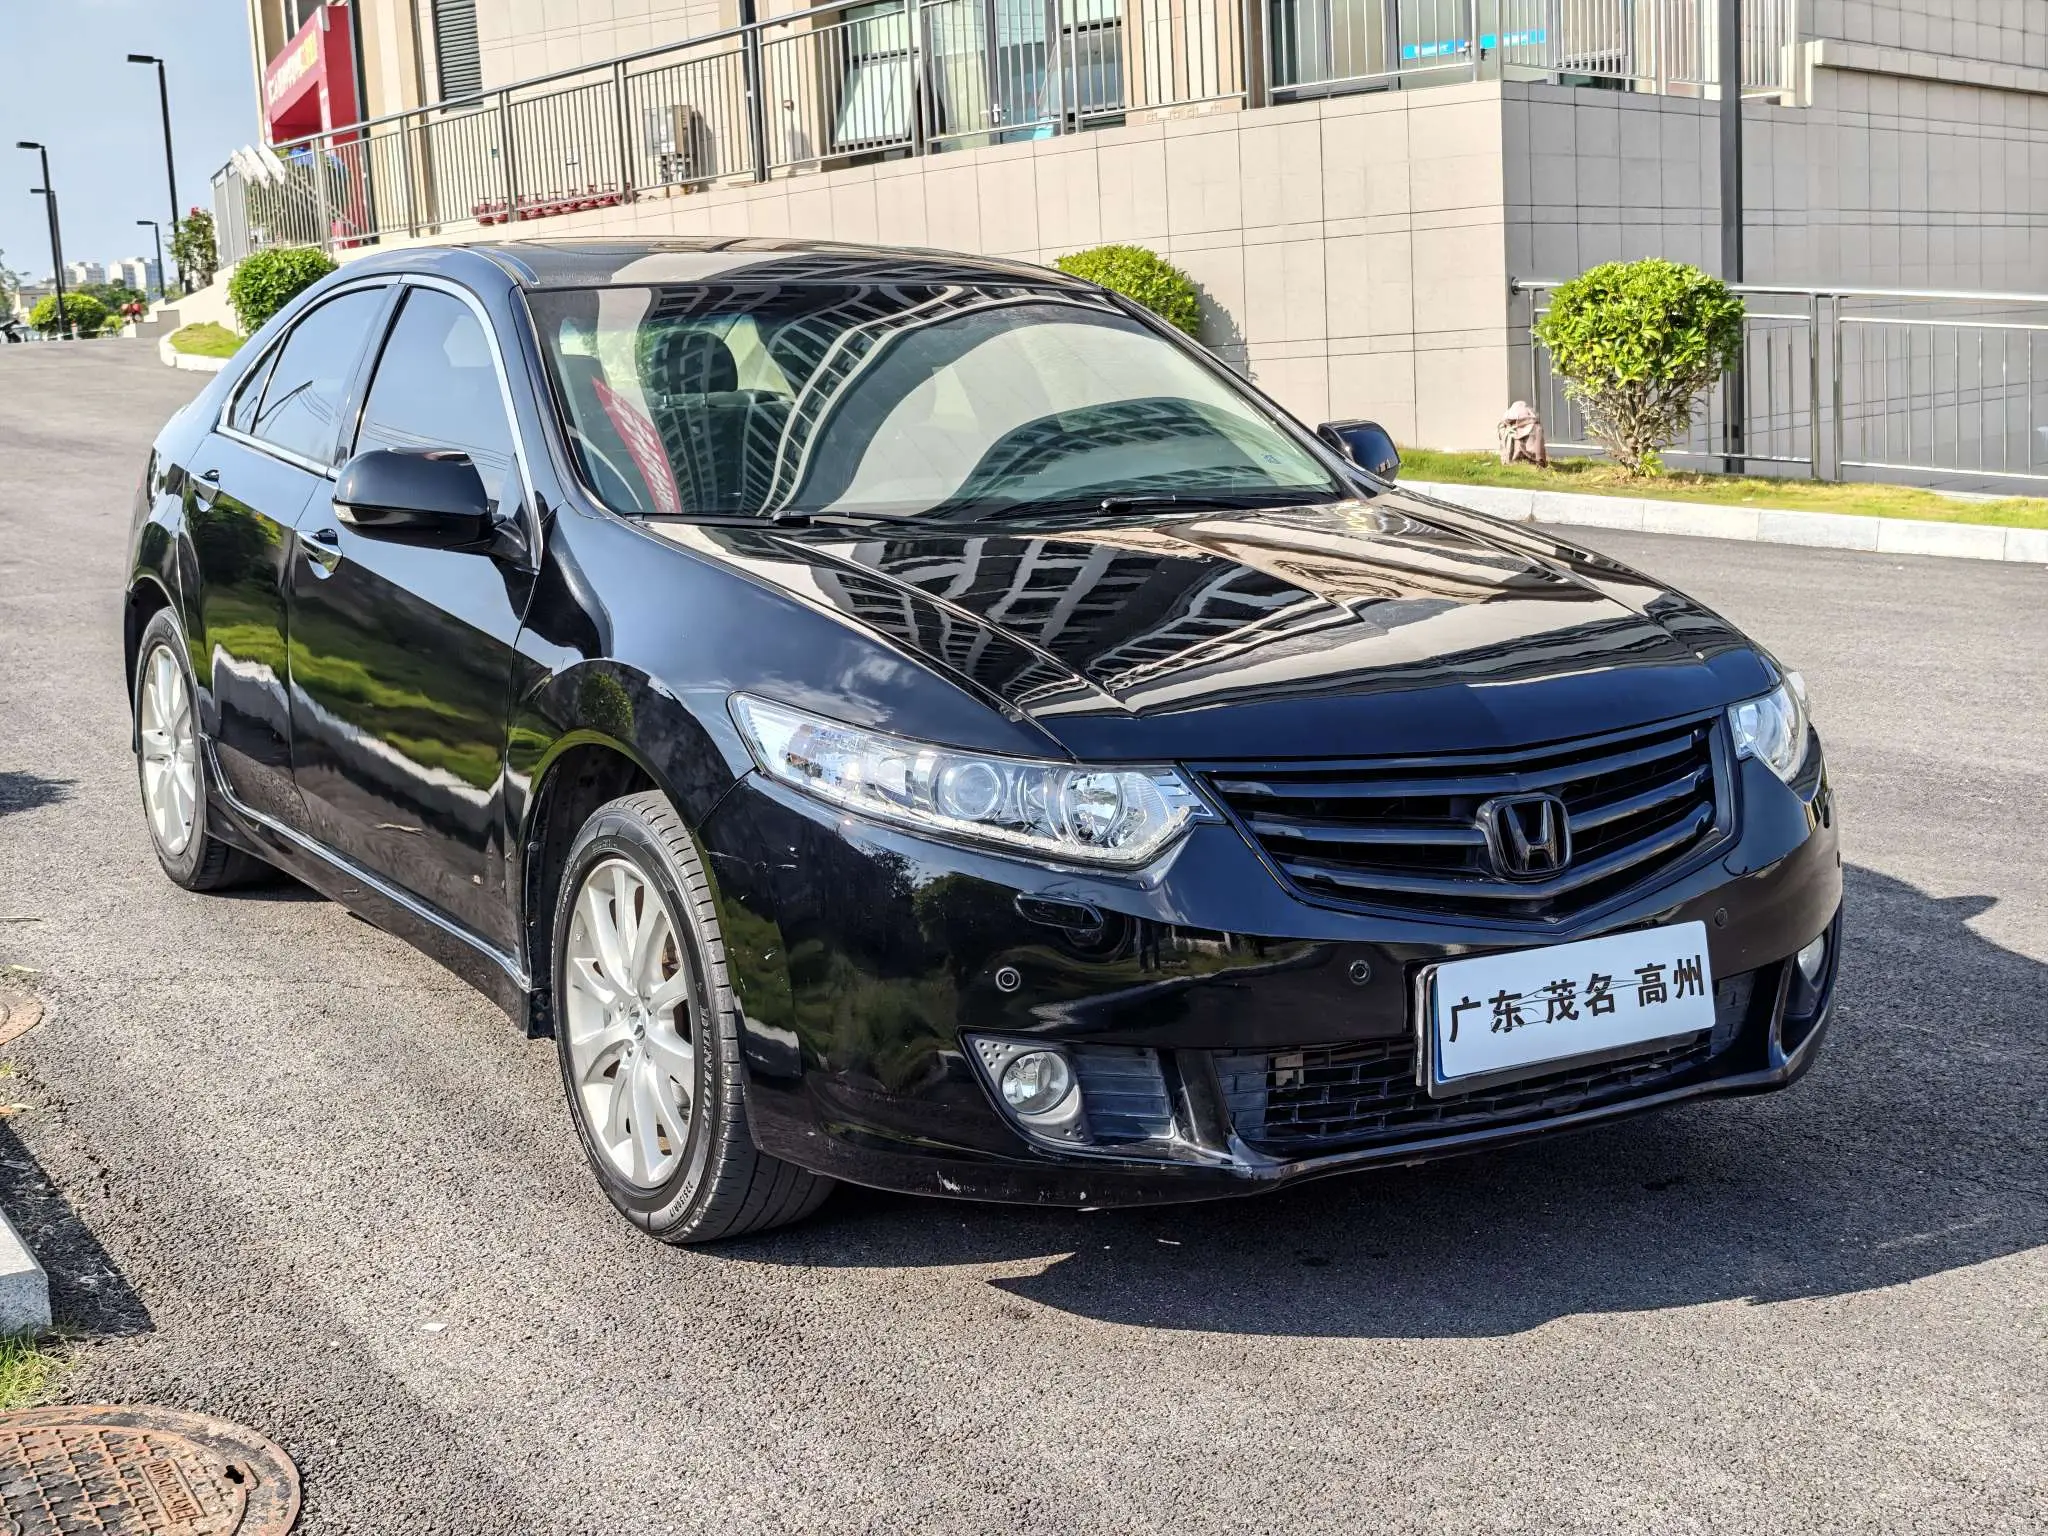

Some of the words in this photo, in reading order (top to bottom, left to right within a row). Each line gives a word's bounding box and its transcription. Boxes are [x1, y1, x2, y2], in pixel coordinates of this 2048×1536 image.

[1449, 990, 1525, 1042] 广东
[1542, 973, 1616, 1024] 茂名
[1634, 954, 1705, 1007] 高州
[699, 1005, 713, 1129] DUNLOP
